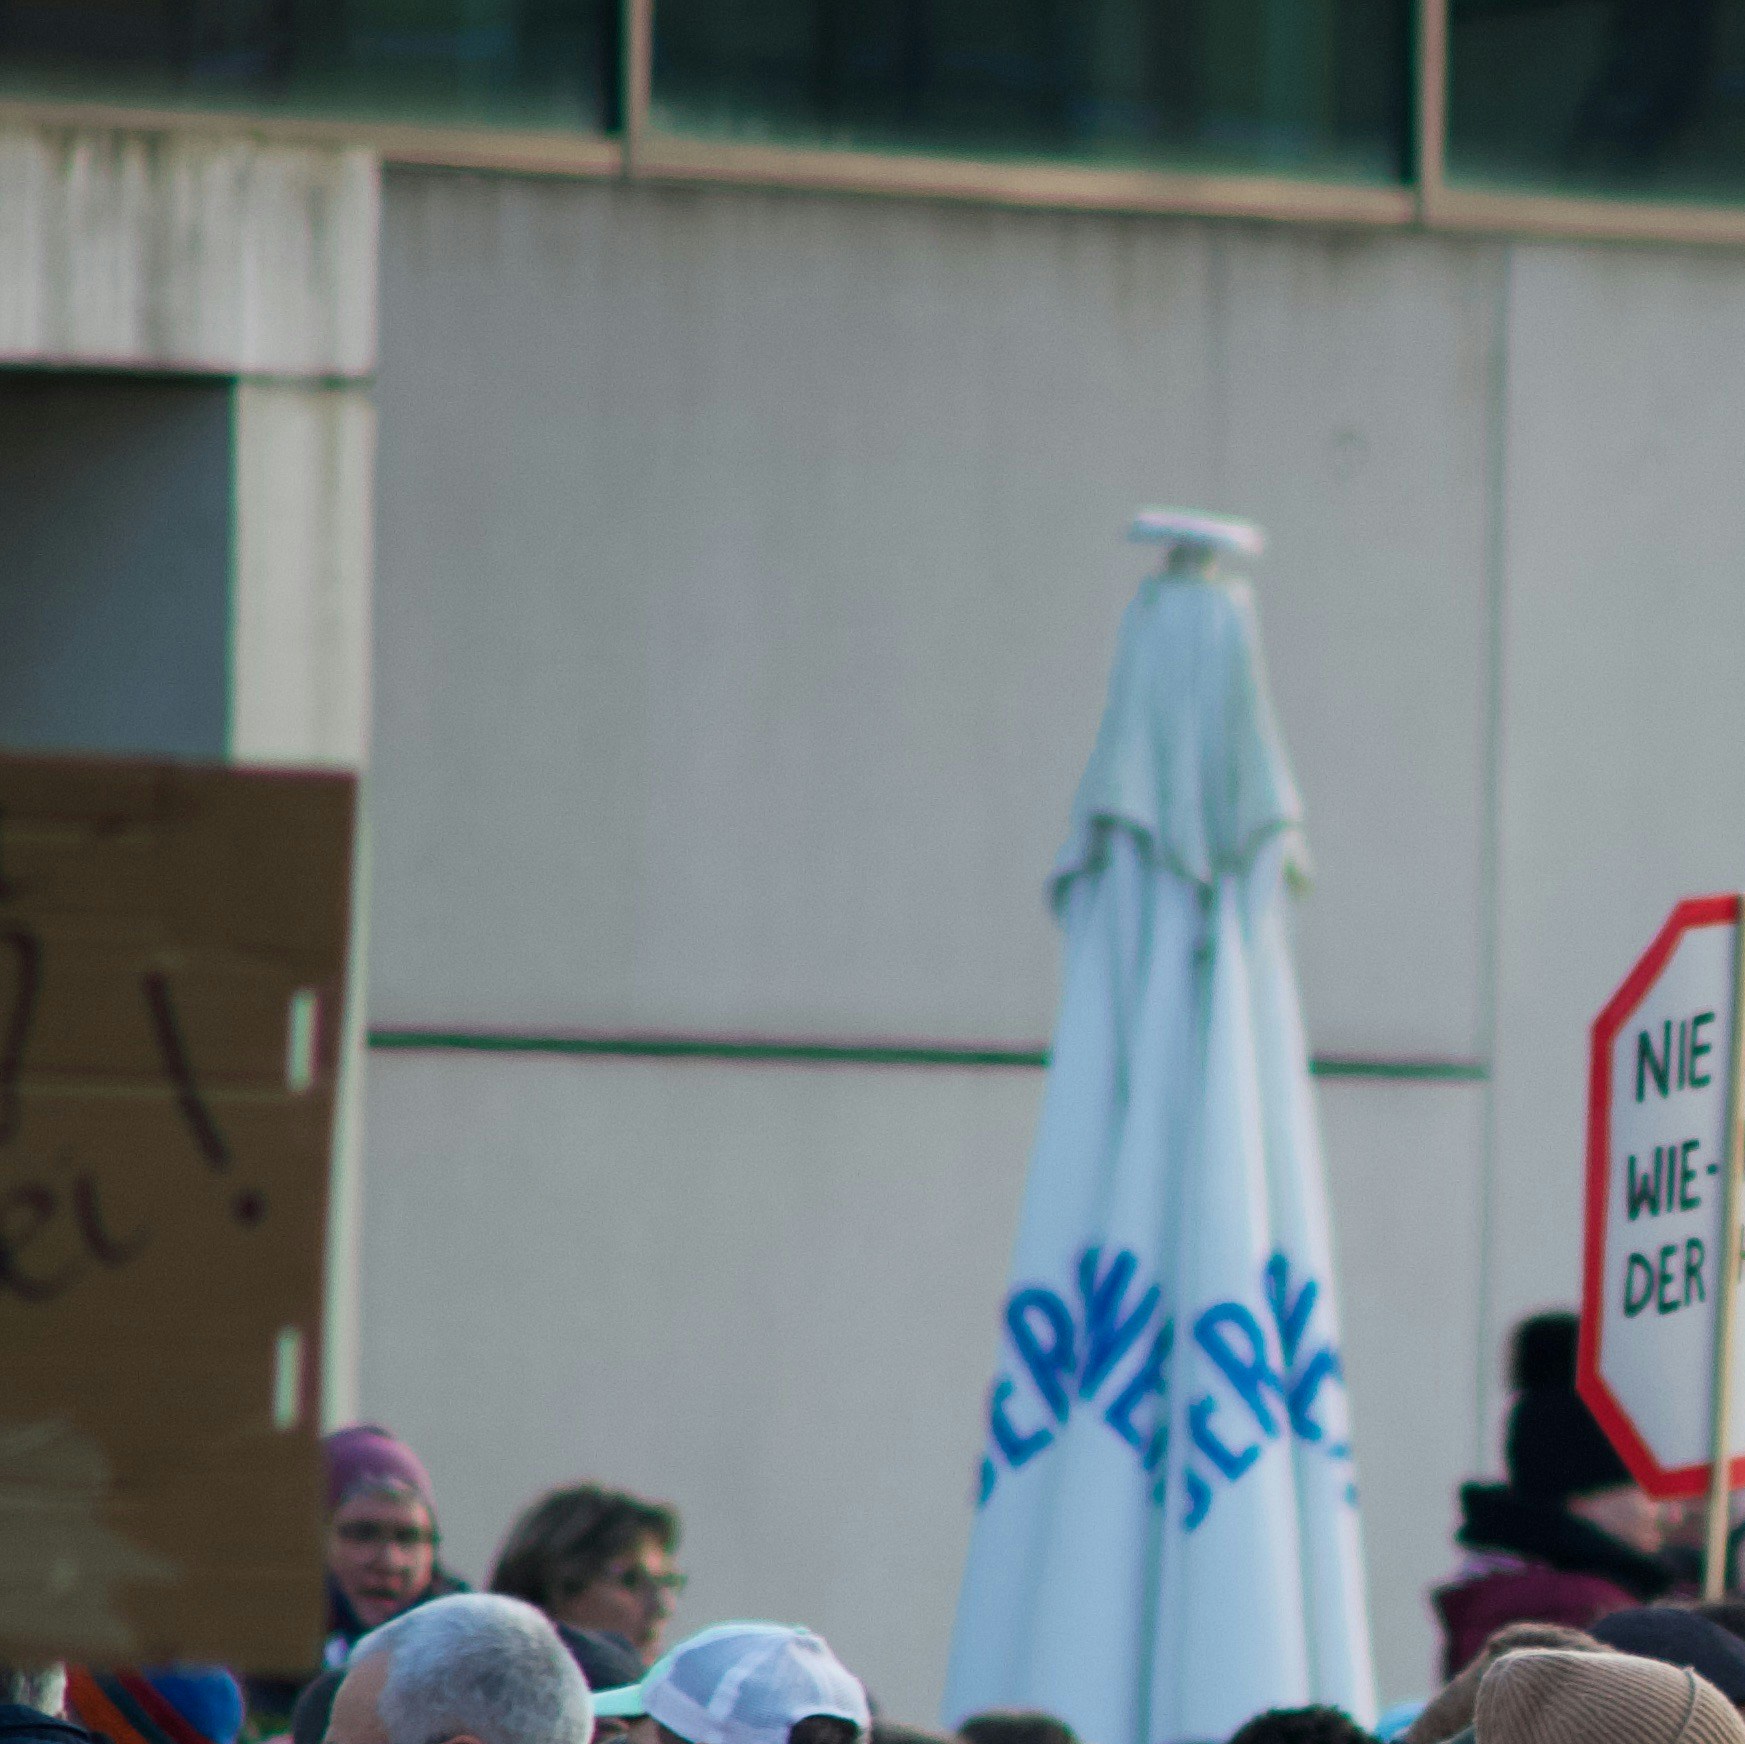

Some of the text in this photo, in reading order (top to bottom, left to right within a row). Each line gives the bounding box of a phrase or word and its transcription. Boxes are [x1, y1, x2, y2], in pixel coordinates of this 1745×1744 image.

[1634, 1010, 1717, 1103] NIE
[1626, 1138, 1721, 1222] WIE-
[1622, 1236, 1707, 1318] DER
